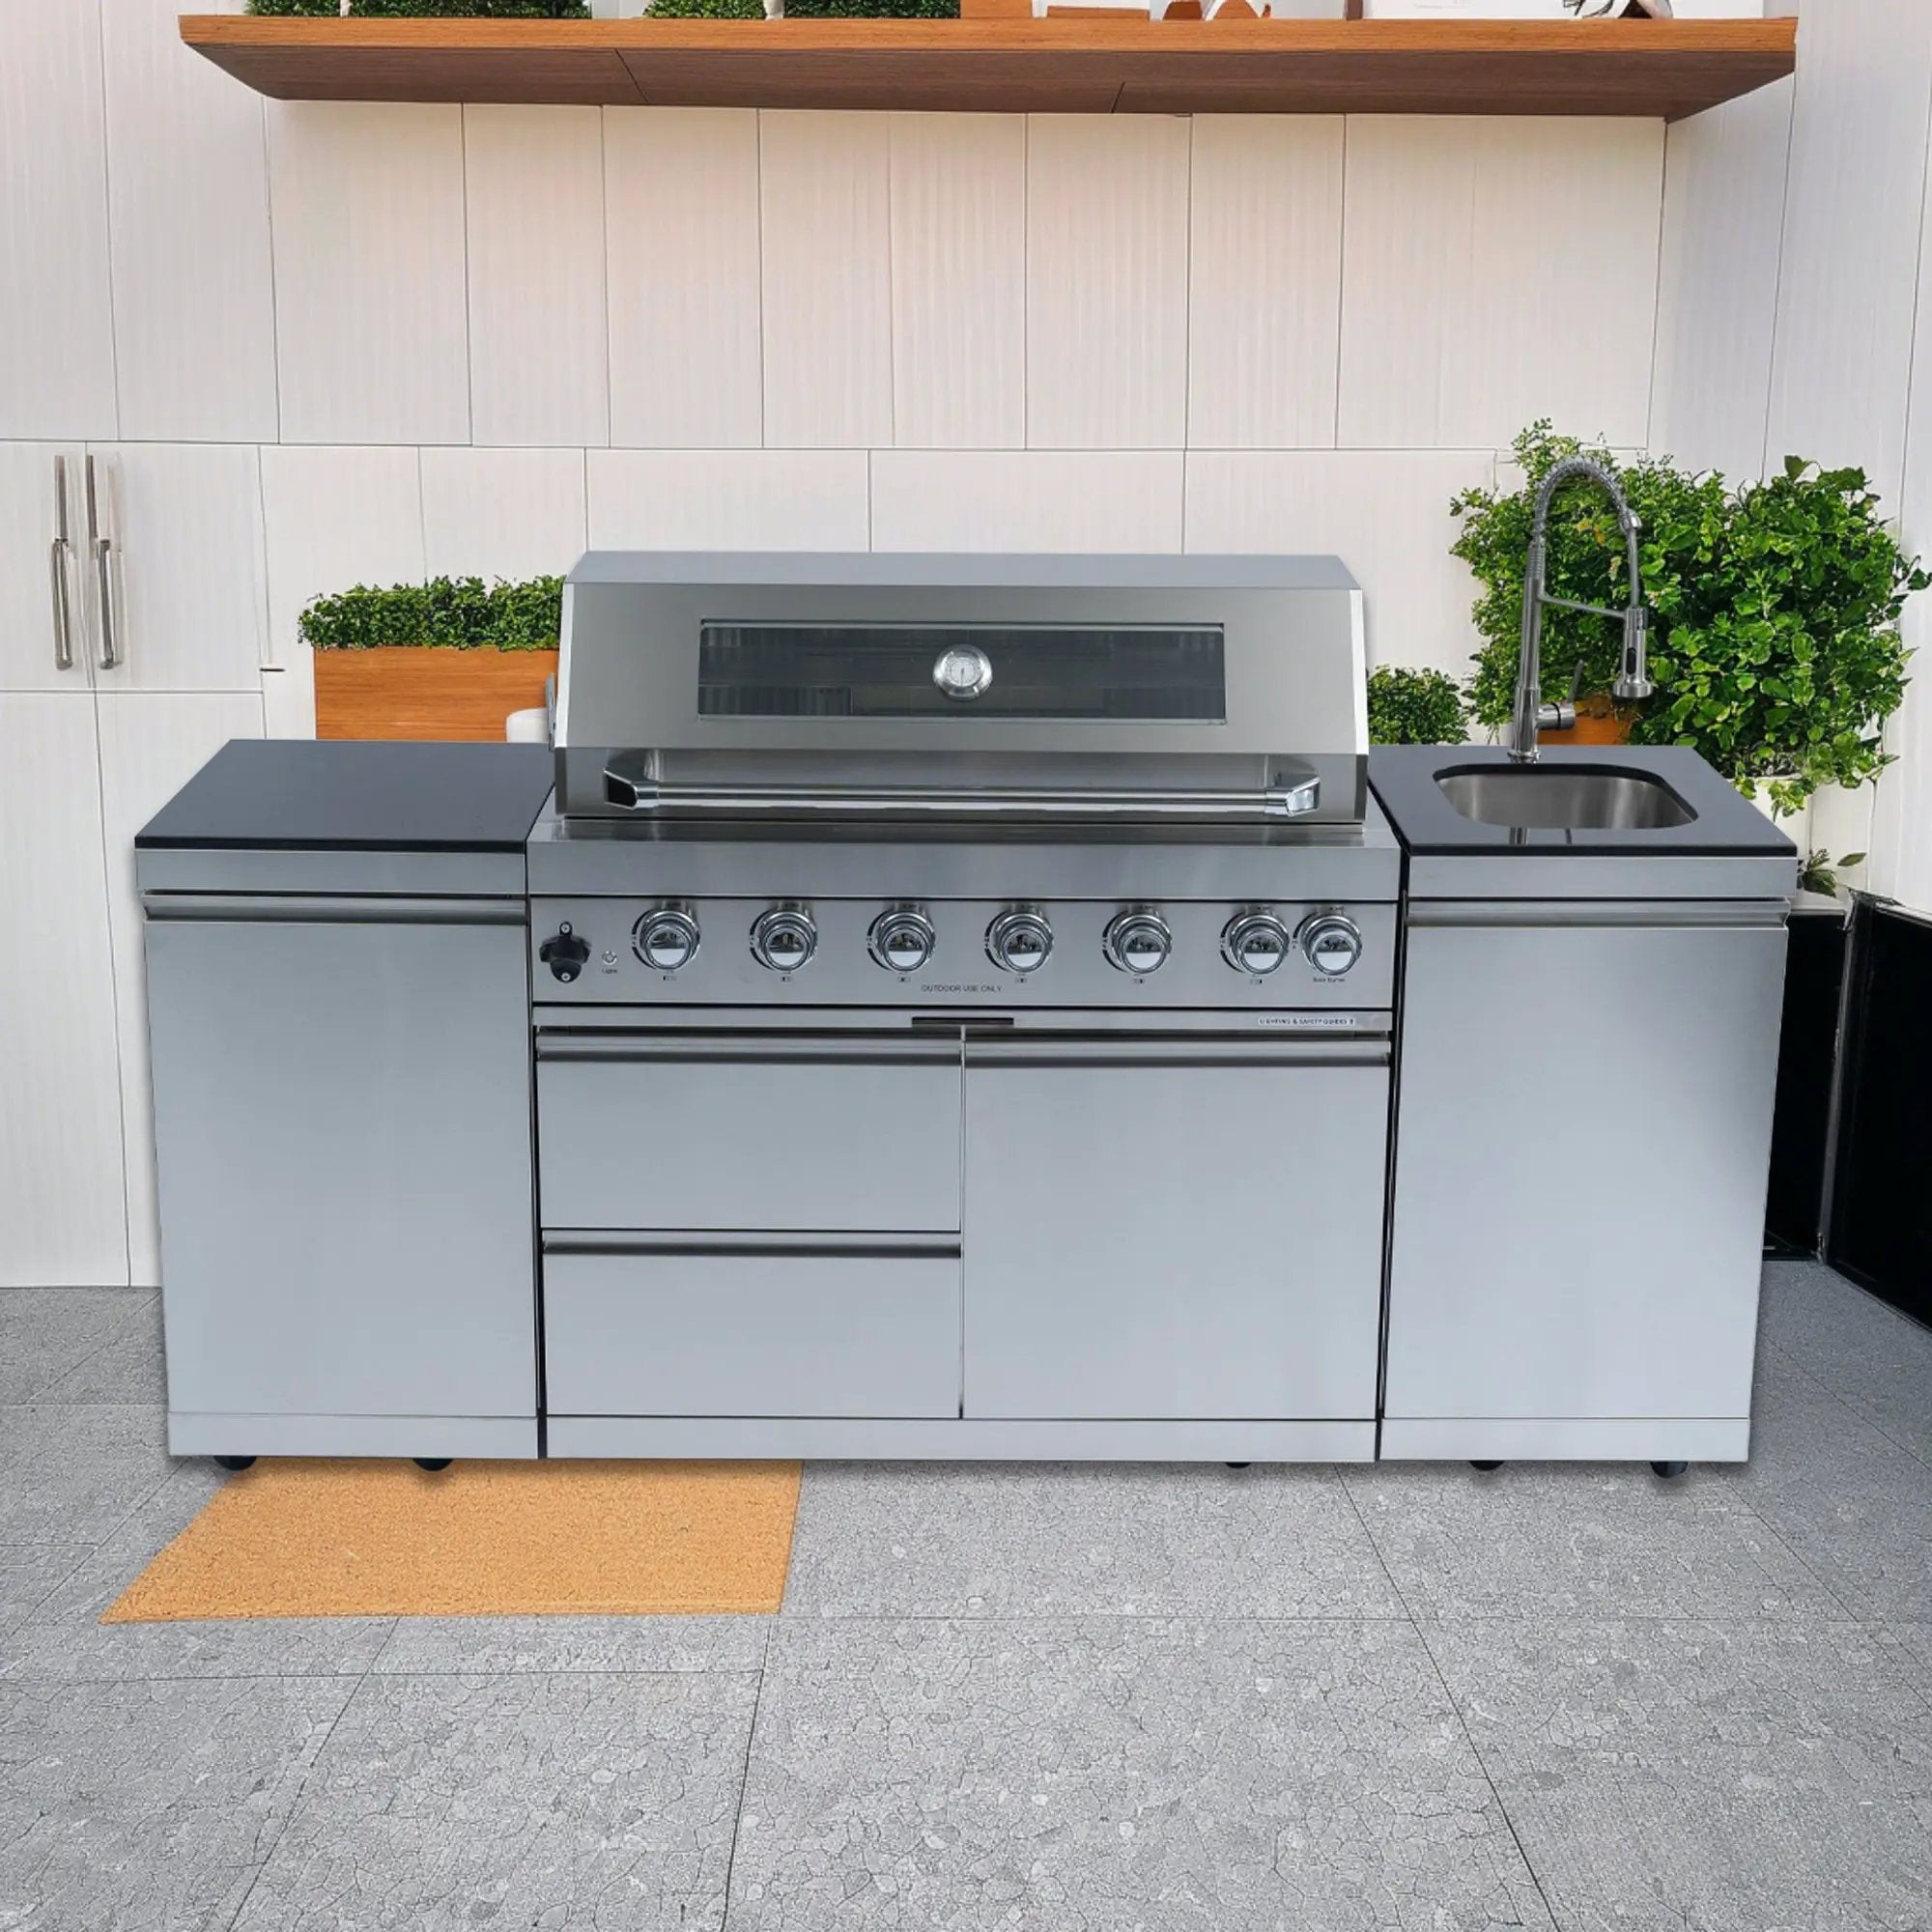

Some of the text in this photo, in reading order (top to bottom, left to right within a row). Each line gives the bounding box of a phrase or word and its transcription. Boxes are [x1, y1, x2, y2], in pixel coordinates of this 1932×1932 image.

[921, 983, 1003, 993] OUTDOOR USE ONLY
